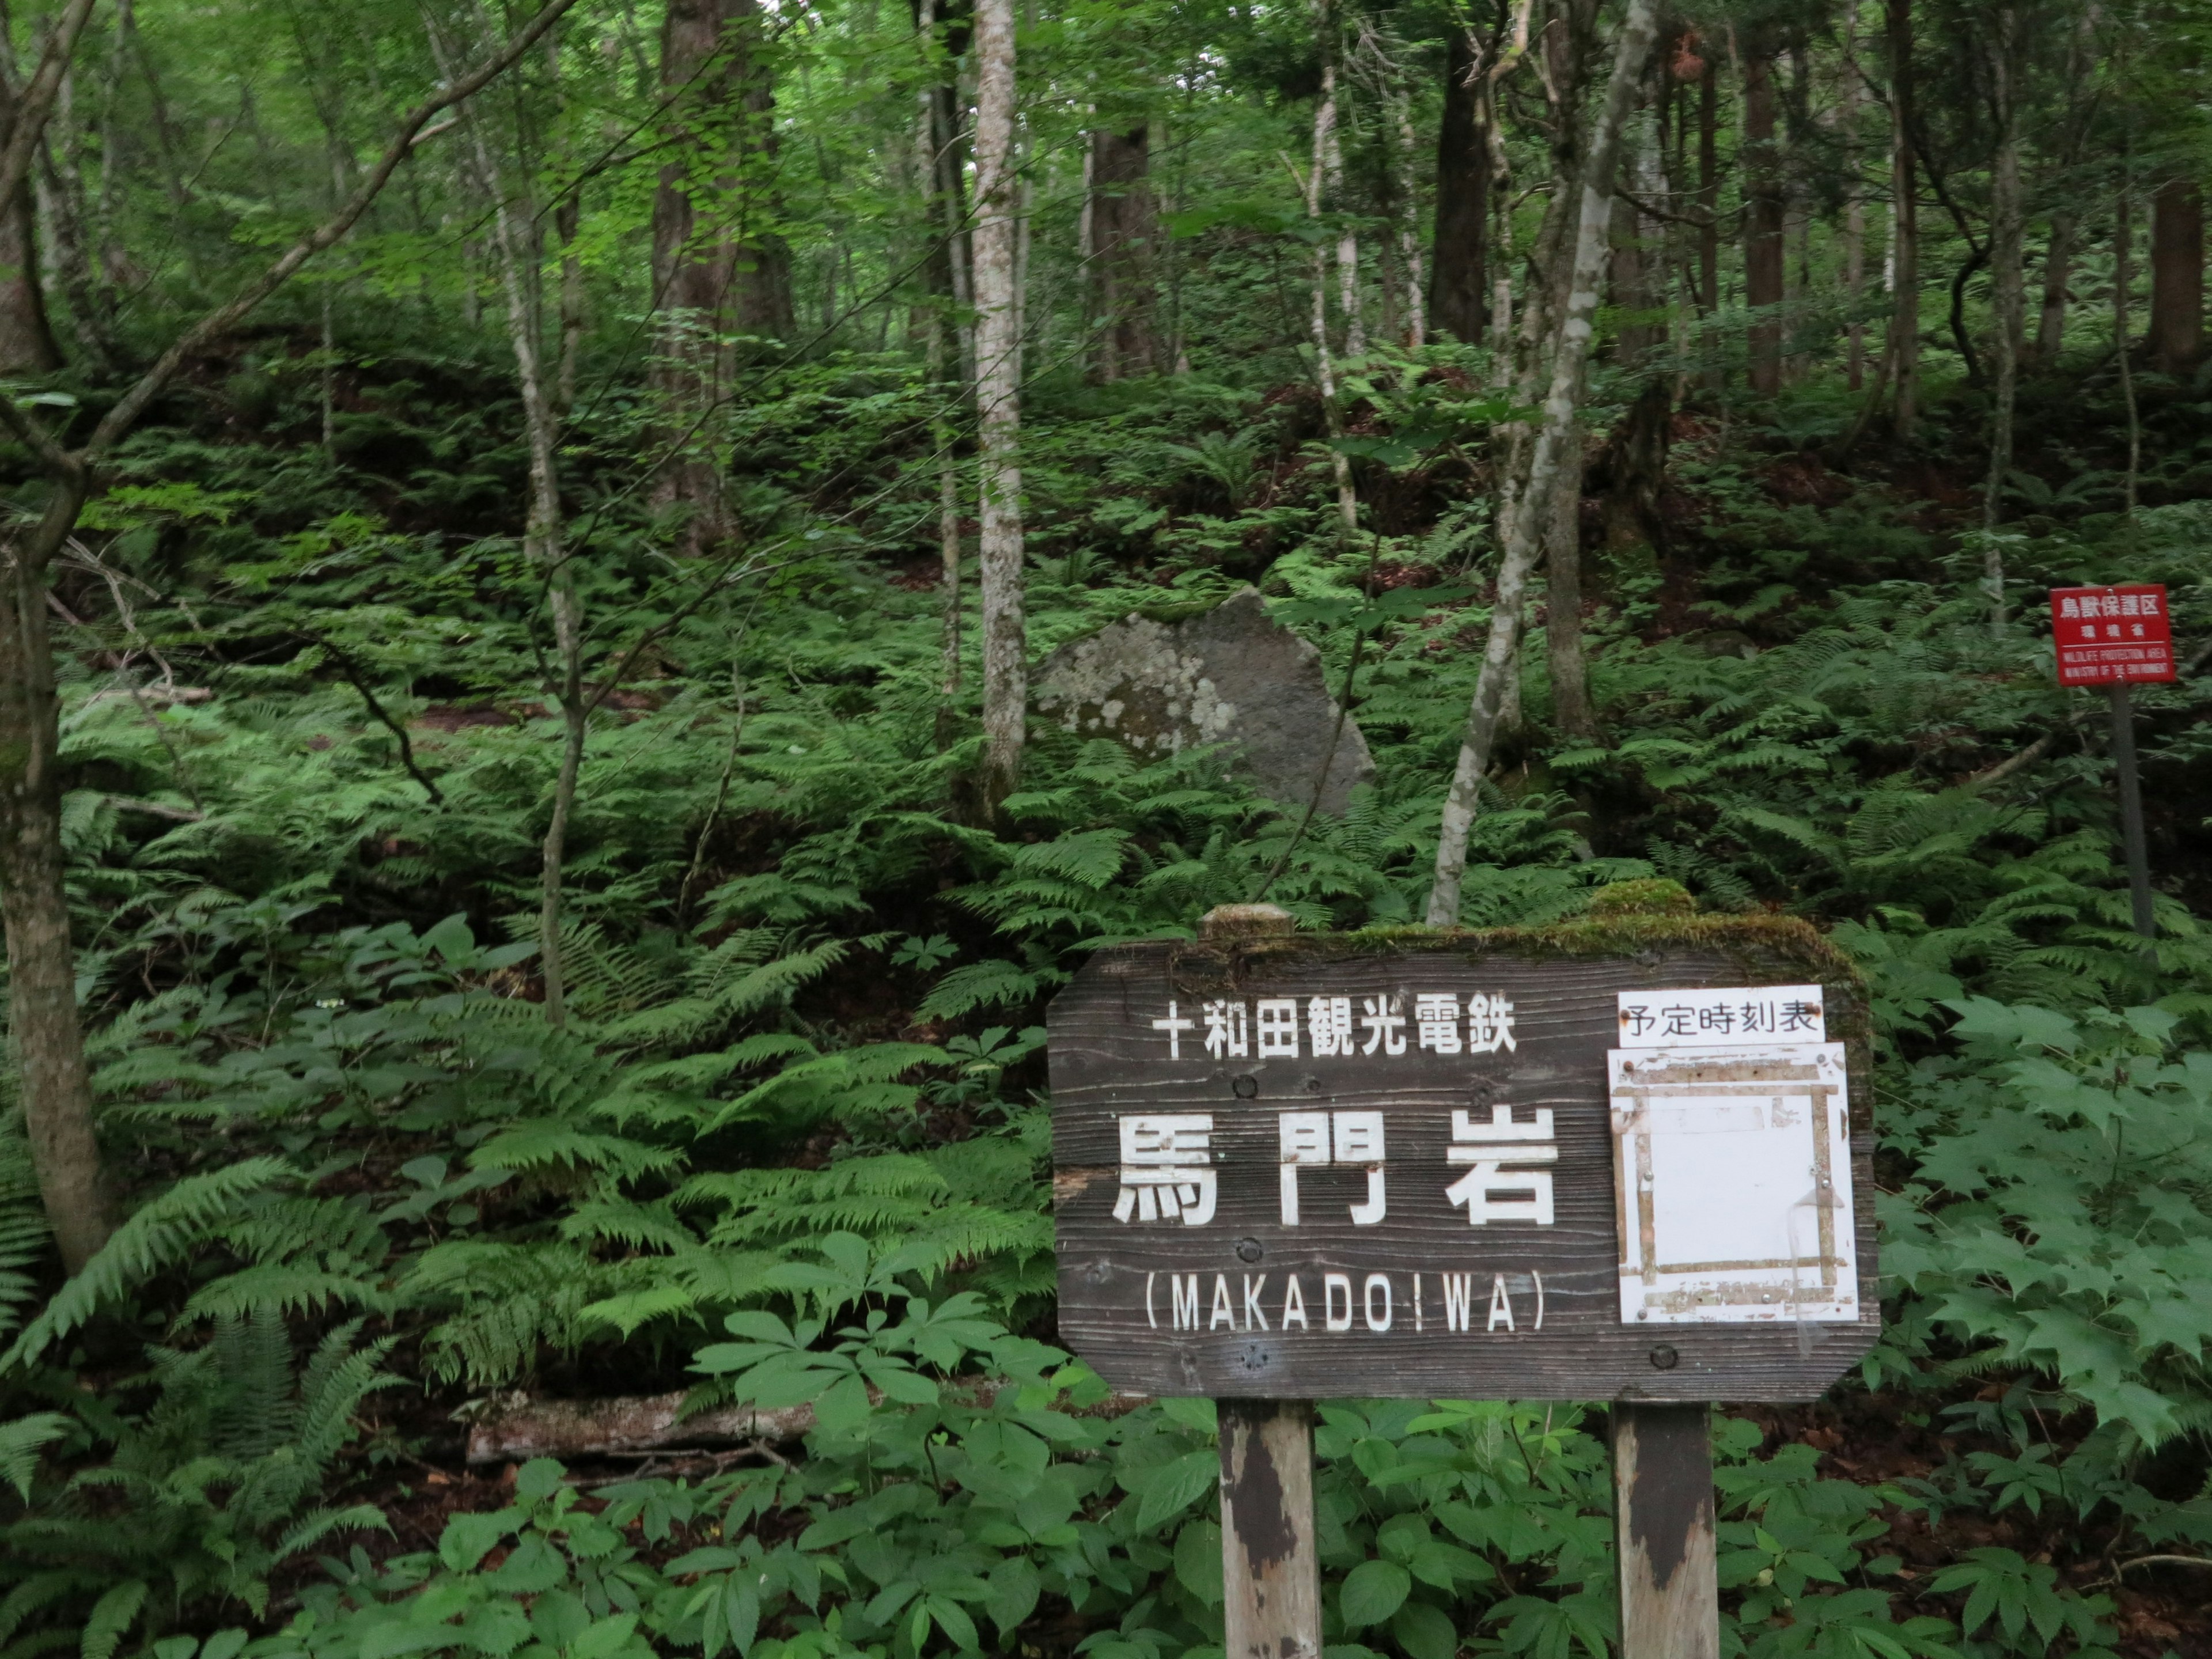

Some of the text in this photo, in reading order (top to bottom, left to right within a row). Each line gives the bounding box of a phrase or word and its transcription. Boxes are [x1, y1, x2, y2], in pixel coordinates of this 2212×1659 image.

[2060, 594, 2160, 618] 鳥獣保護区
[2063, 647, 2168, 662] WILDLIFE PROTECTION AREA
[1153, 990, 1517, 1060] 十和田観光電鉄
[1626, 999, 1819, 1037] 予定時刻表
[1112, 1104, 1559, 1226] 馬門岩
